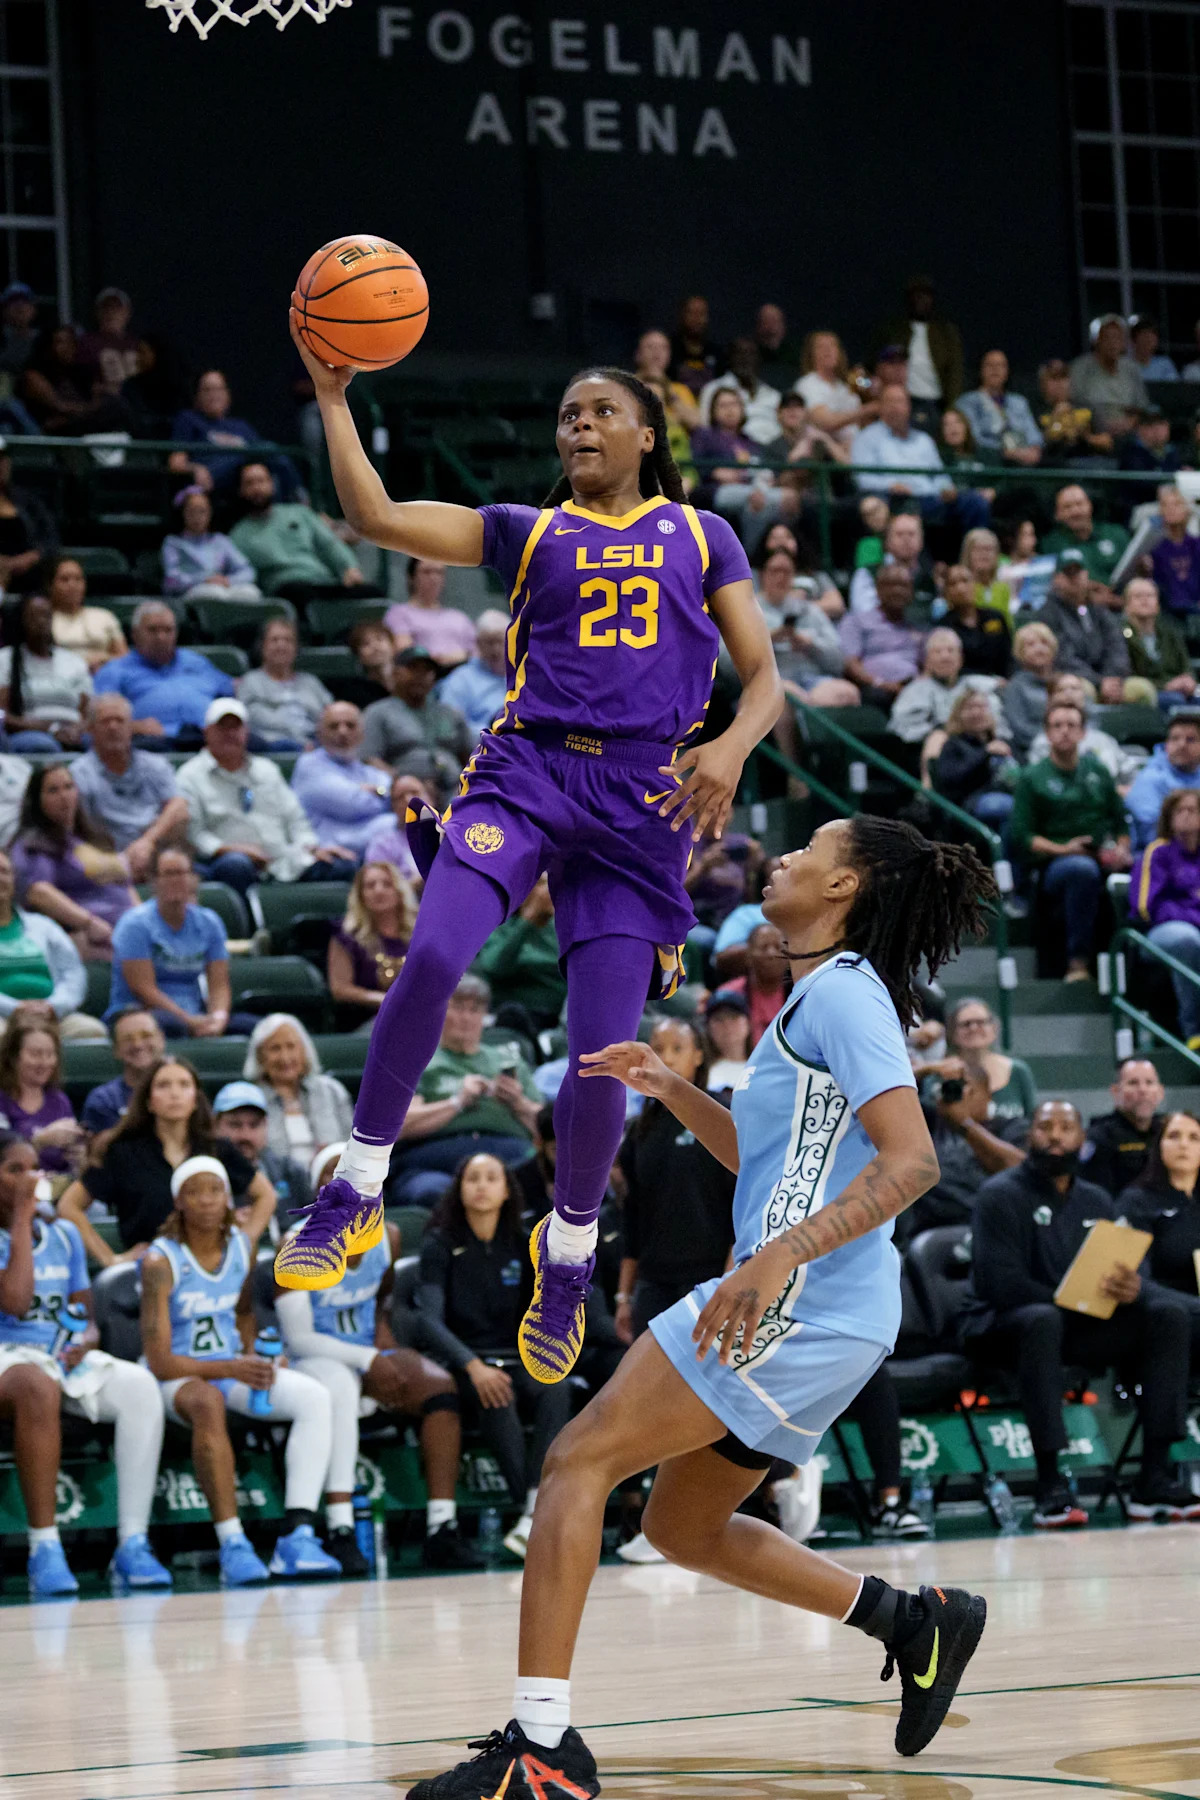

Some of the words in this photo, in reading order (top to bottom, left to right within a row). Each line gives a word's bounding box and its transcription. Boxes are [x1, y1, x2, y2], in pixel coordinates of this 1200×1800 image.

[377, 5, 812, 86] FOGELMAN
[466, 92, 737, 158] ARENA
[658, 520, 676, 533] SEC
[575, 544, 664, 570] LSU
[579, 575, 660, 650] 23
[564, 740, 603, 756] TIGERS
[567, 733, 602, 747] GEAUX
[194, 1315, 224, 1352] 21
